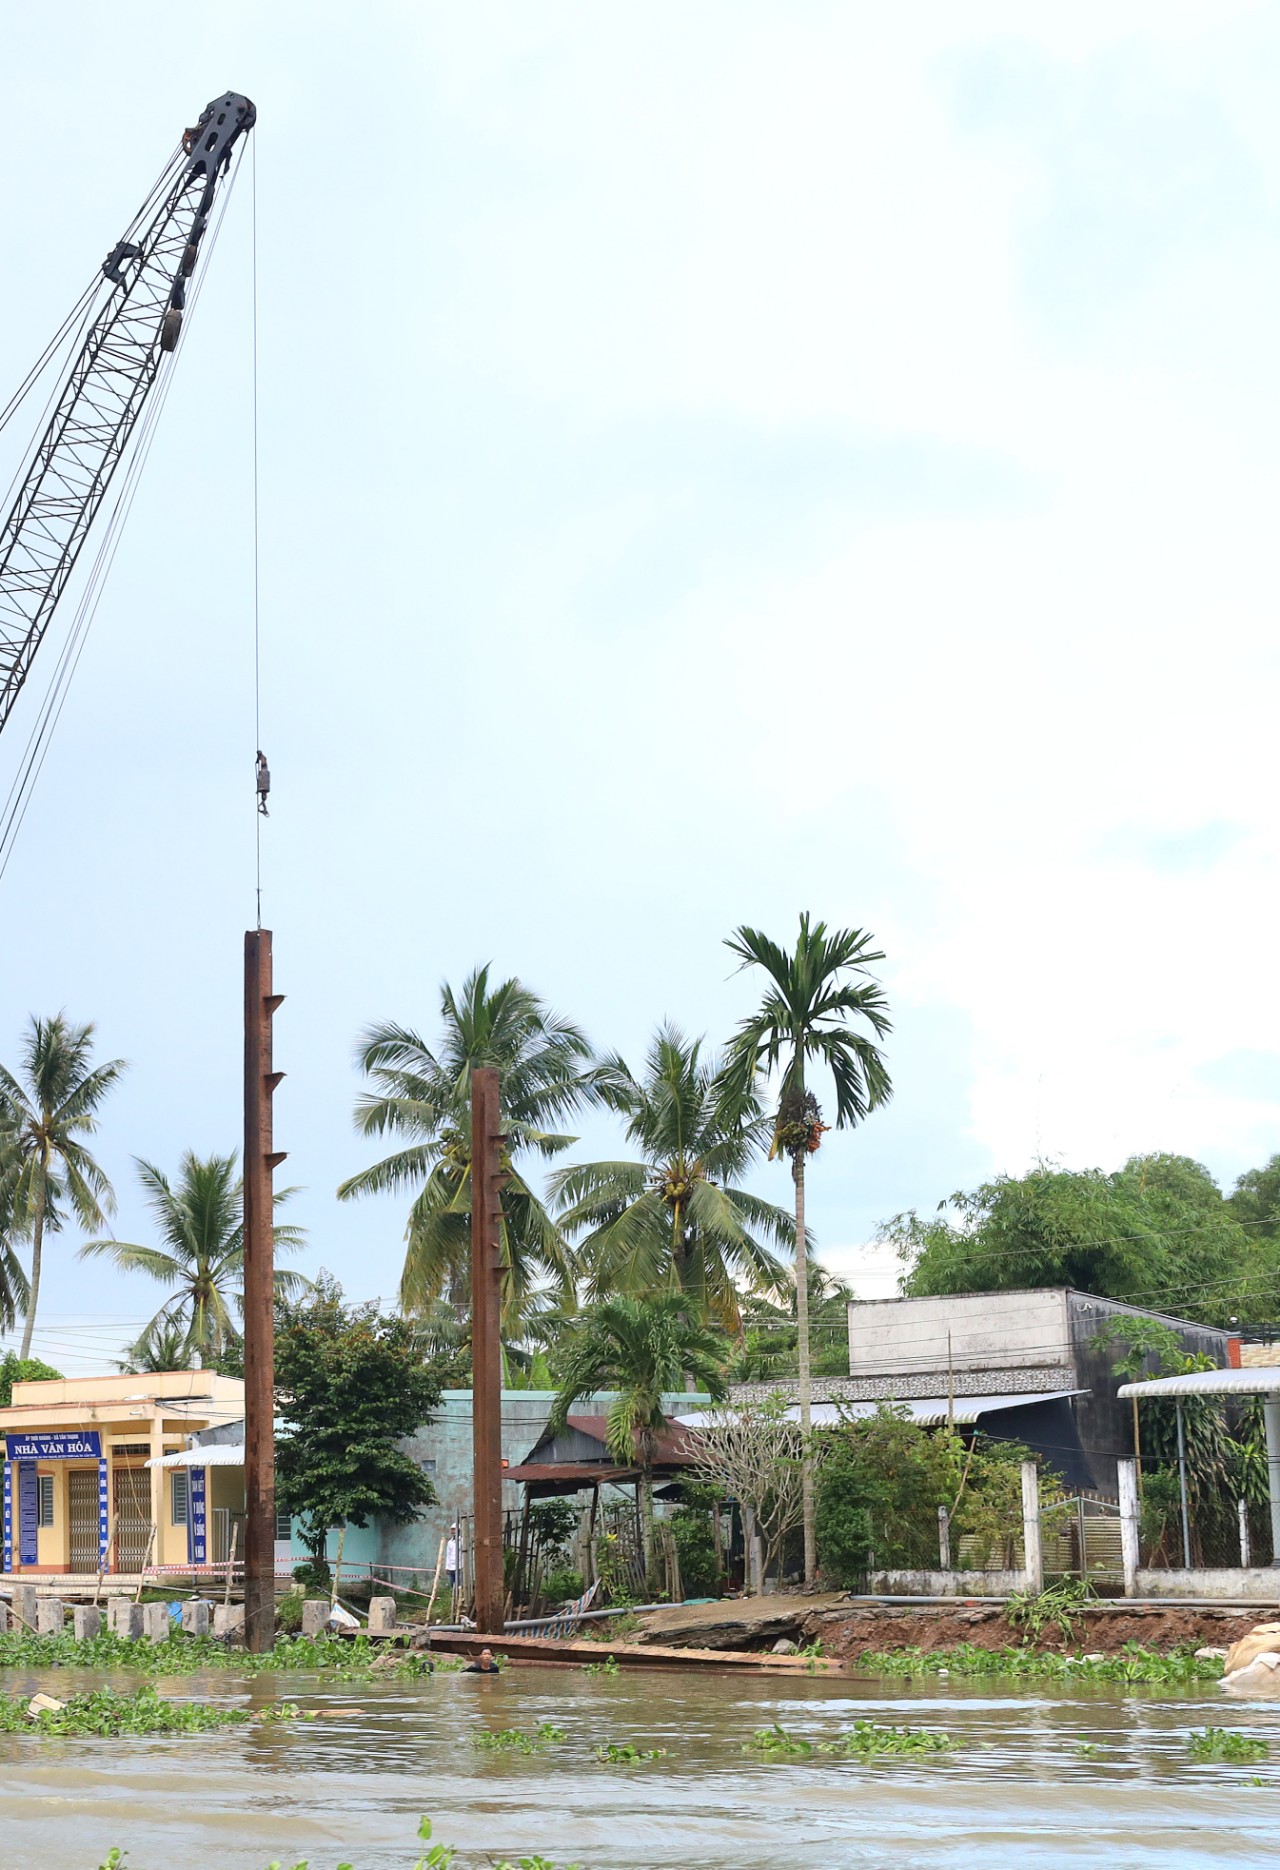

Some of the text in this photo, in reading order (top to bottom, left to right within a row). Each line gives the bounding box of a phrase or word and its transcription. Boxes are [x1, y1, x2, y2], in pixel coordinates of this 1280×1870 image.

[15, 1441, 93, 1454] NHÀ VĂN HÓA
